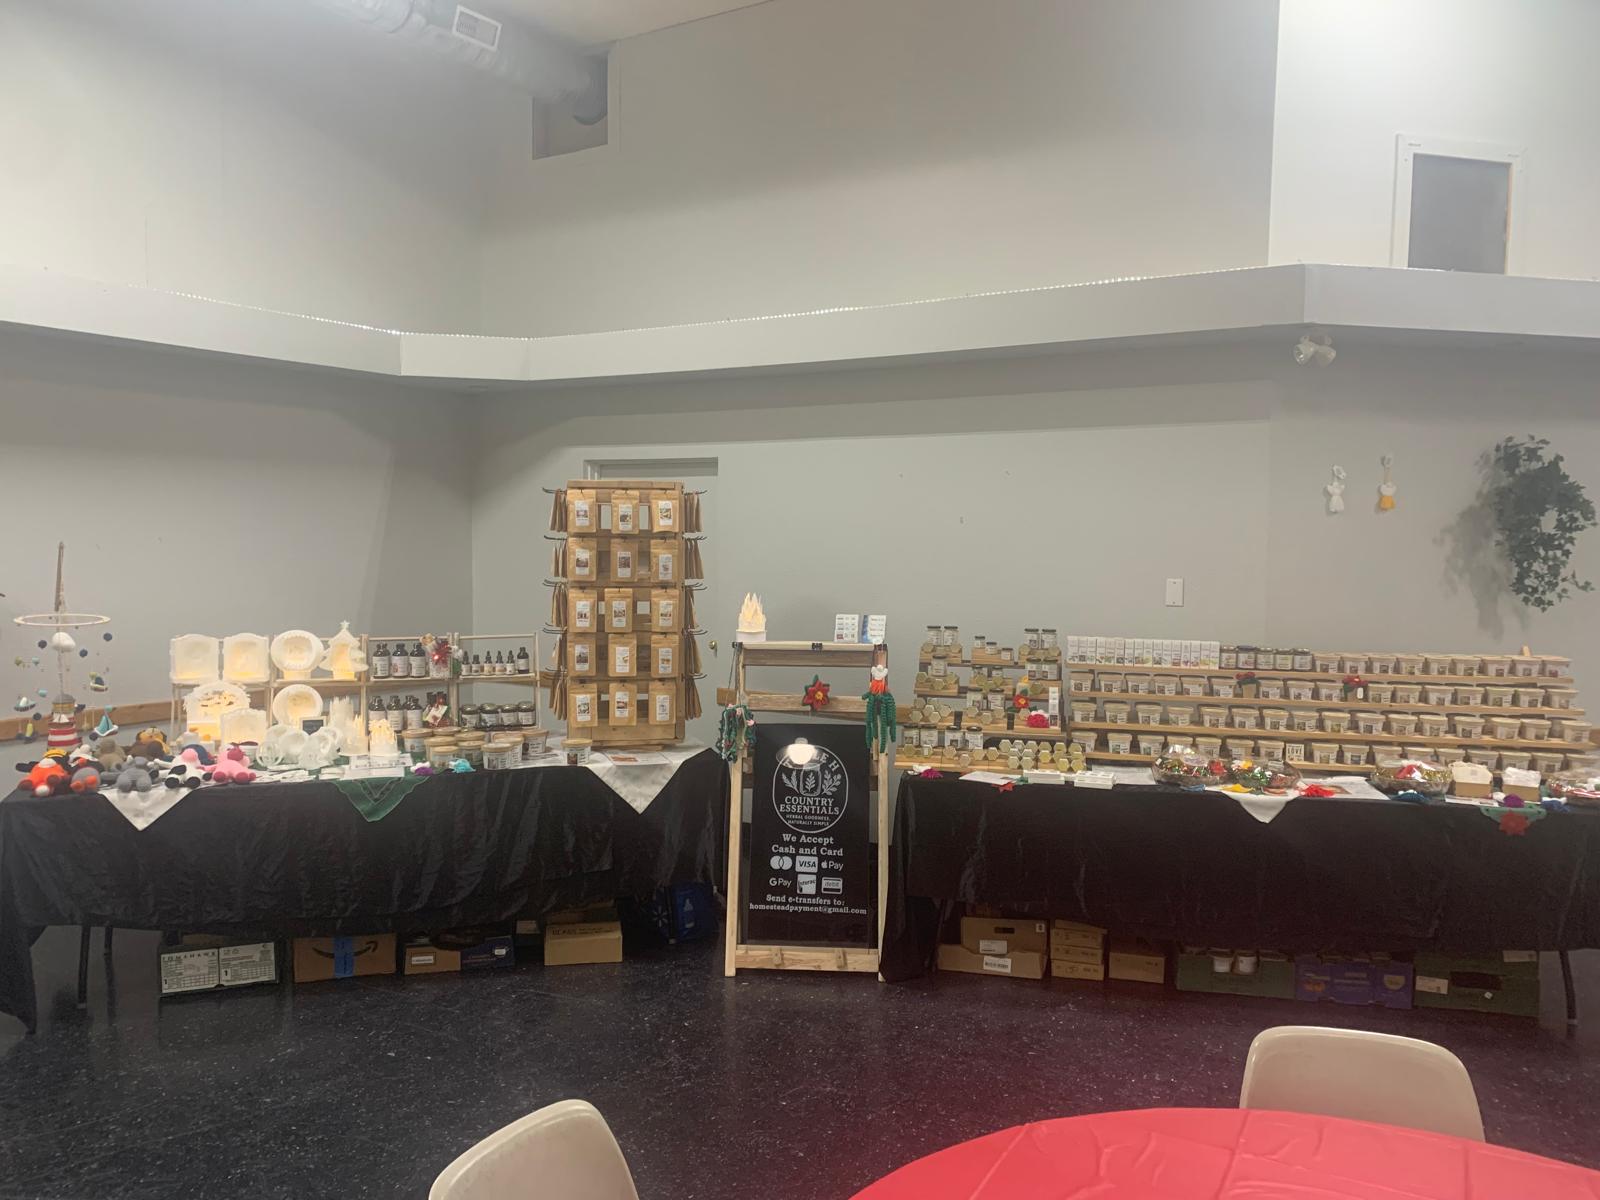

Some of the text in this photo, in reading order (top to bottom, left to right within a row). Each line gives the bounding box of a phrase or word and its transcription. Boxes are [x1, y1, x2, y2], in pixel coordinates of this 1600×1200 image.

[828, 760, 840, 771] H
[785, 796, 834, 806] COUNTRY
[779, 804, 840, 815] ESSENTIALS
[782, 833, 834, 846] We Accept
[771, 844, 844, 856] Cash and Card
[798, 860, 816, 868] VISA
[828, 861, 844, 871] Pay
[766, 894, 785, 903] Send
[788, 895, 831, 905] e-transfers
[749, 902, 867, 915] homesteadpayment@gmail.com
